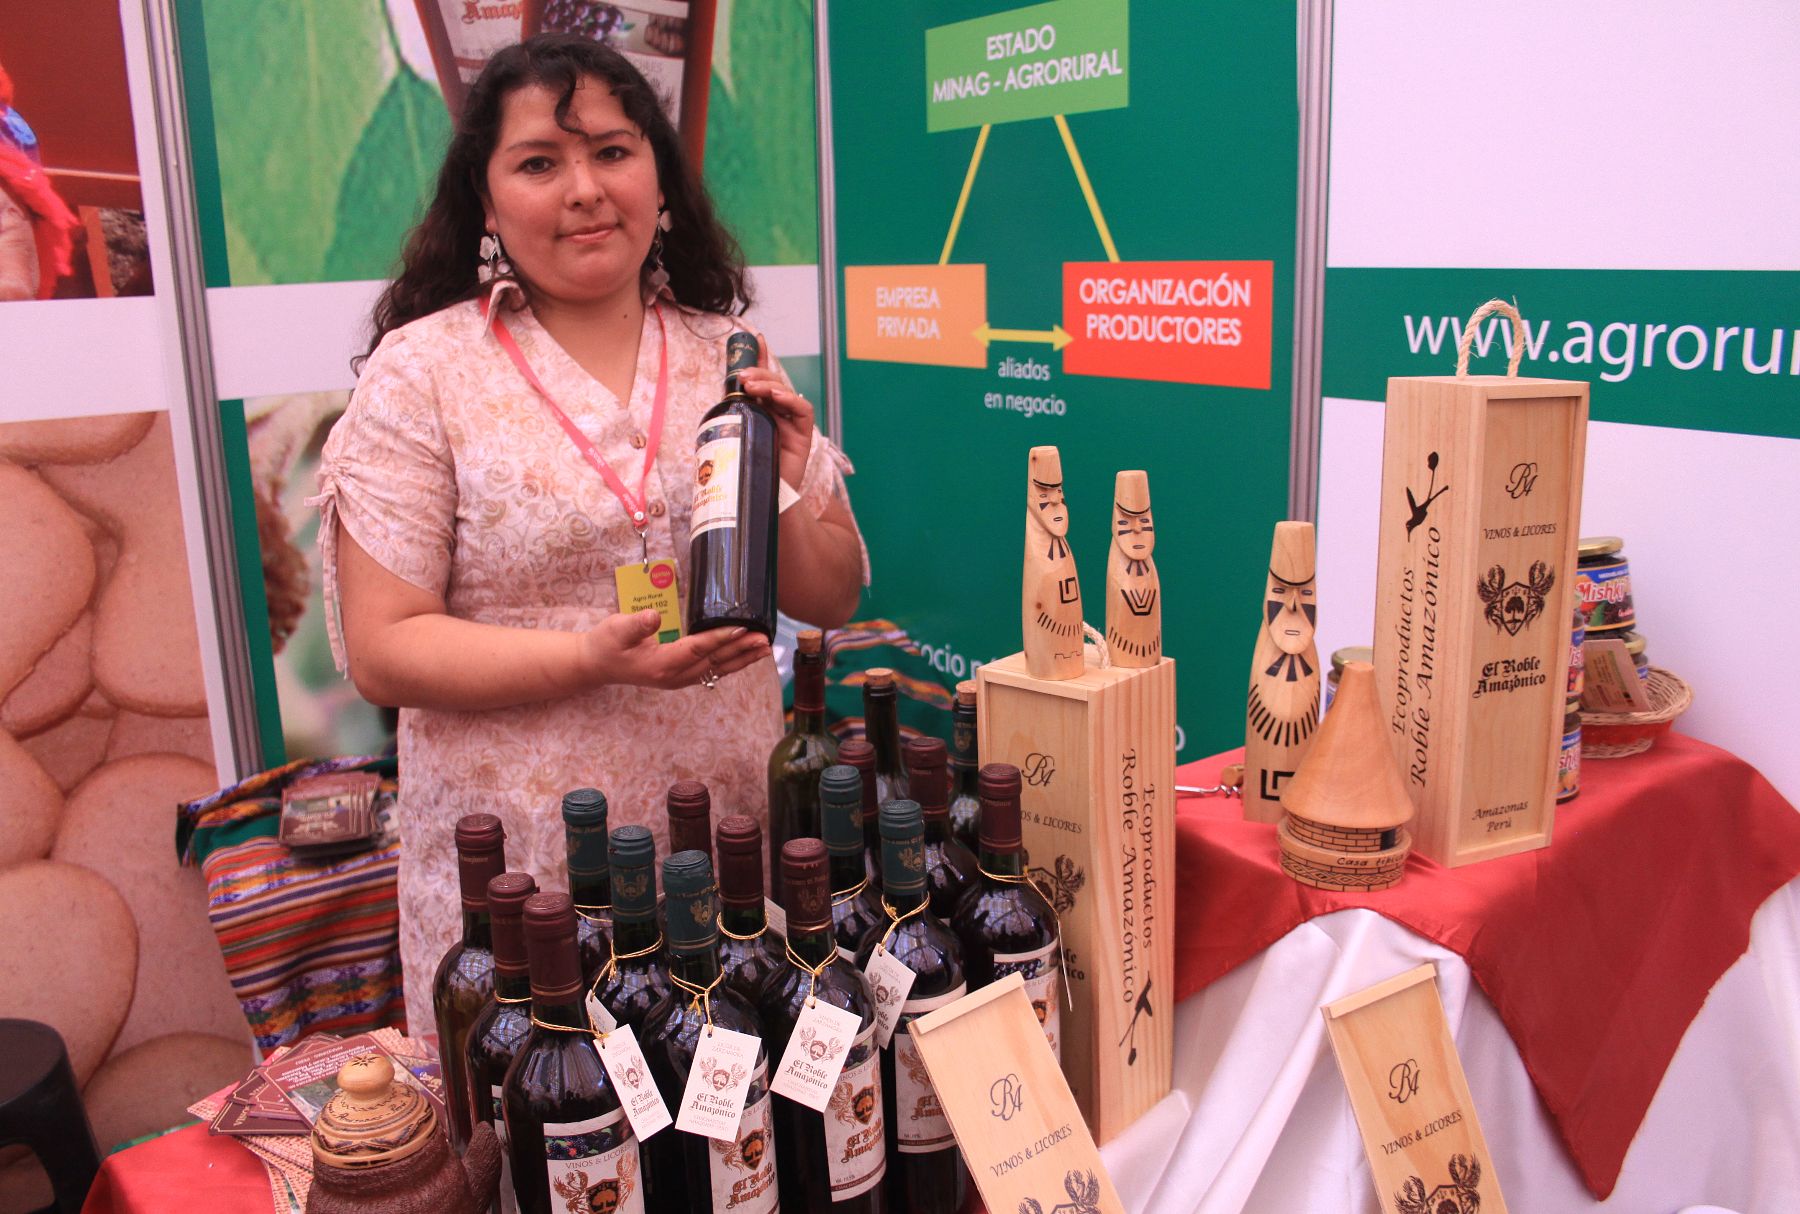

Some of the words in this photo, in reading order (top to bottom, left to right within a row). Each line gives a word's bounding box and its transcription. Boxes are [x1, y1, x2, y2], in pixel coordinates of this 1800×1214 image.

[987, 24, 1056, 61] ESTADO
[932, 70, 991, 104] MINAG
[1004, 48, 1123, 93] AGRORURAL
[876, 286, 941, 310] EMPRESA
[1079, 272, 1252, 308] ORGANIZACIÓN
[876, 315, 941, 340] PRIVADA
[1086, 313, 1243, 348] PRODUCTORES
[997, 356, 1051, 381] aliados
[983, 389, 1003, 410] en
[1004, 391, 1067, 419] negocio
[1484, 527, 1511, 540] VINOS
[1512, 529, 1520, 538] &
[1521, 523, 1557, 538] LICORES
[631, 602, 653, 613] Stand
[654, 600, 668, 609] 102
[1416, 526, 1442, 700] Amazónico
[920, 643, 966, 679] ocio
[1391, 567, 1415, 736] Ecoproductos
[1481, 662, 1499, 678] El
[1500, 656, 1541, 679] Roble
[1472, 673, 1546, 699] Amazónico
[1410, 706, 1431, 789] Roble
[1122, 748, 1139, 834] Roble
[1471, 800, 1529, 821] Amazonas
[1033, 814, 1041, 825] &
[1042, 814, 1083, 835] LICORES
[1486, 818, 1512, 833] Perú
[1139, 783, 1157, 949] Ecoproductos
[1336, 856, 1369, 867] Casa
[1122, 843, 1138, 1004] Amazónico
[793, 1058, 805, 1071] El
[804, 1061, 829, 1080] Roble
[688, 1100, 737, 1119] Amazónico
[696, 1092, 706, 1102] El
[709, 1094, 735, 1110] Roble
[1381, 1131, 1414, 1157] VINOS
[1414, 1128, 1424, 1142] &
[1423, 1110, 1464, 1139] LICORES
[989, 1152, 1025, 1179] VINOS
[1025, 1147, 1034, 1161] &
[1034, 1122, 1073, 1157] LICORES
[564, 1158, 594, 1170] VINOS
